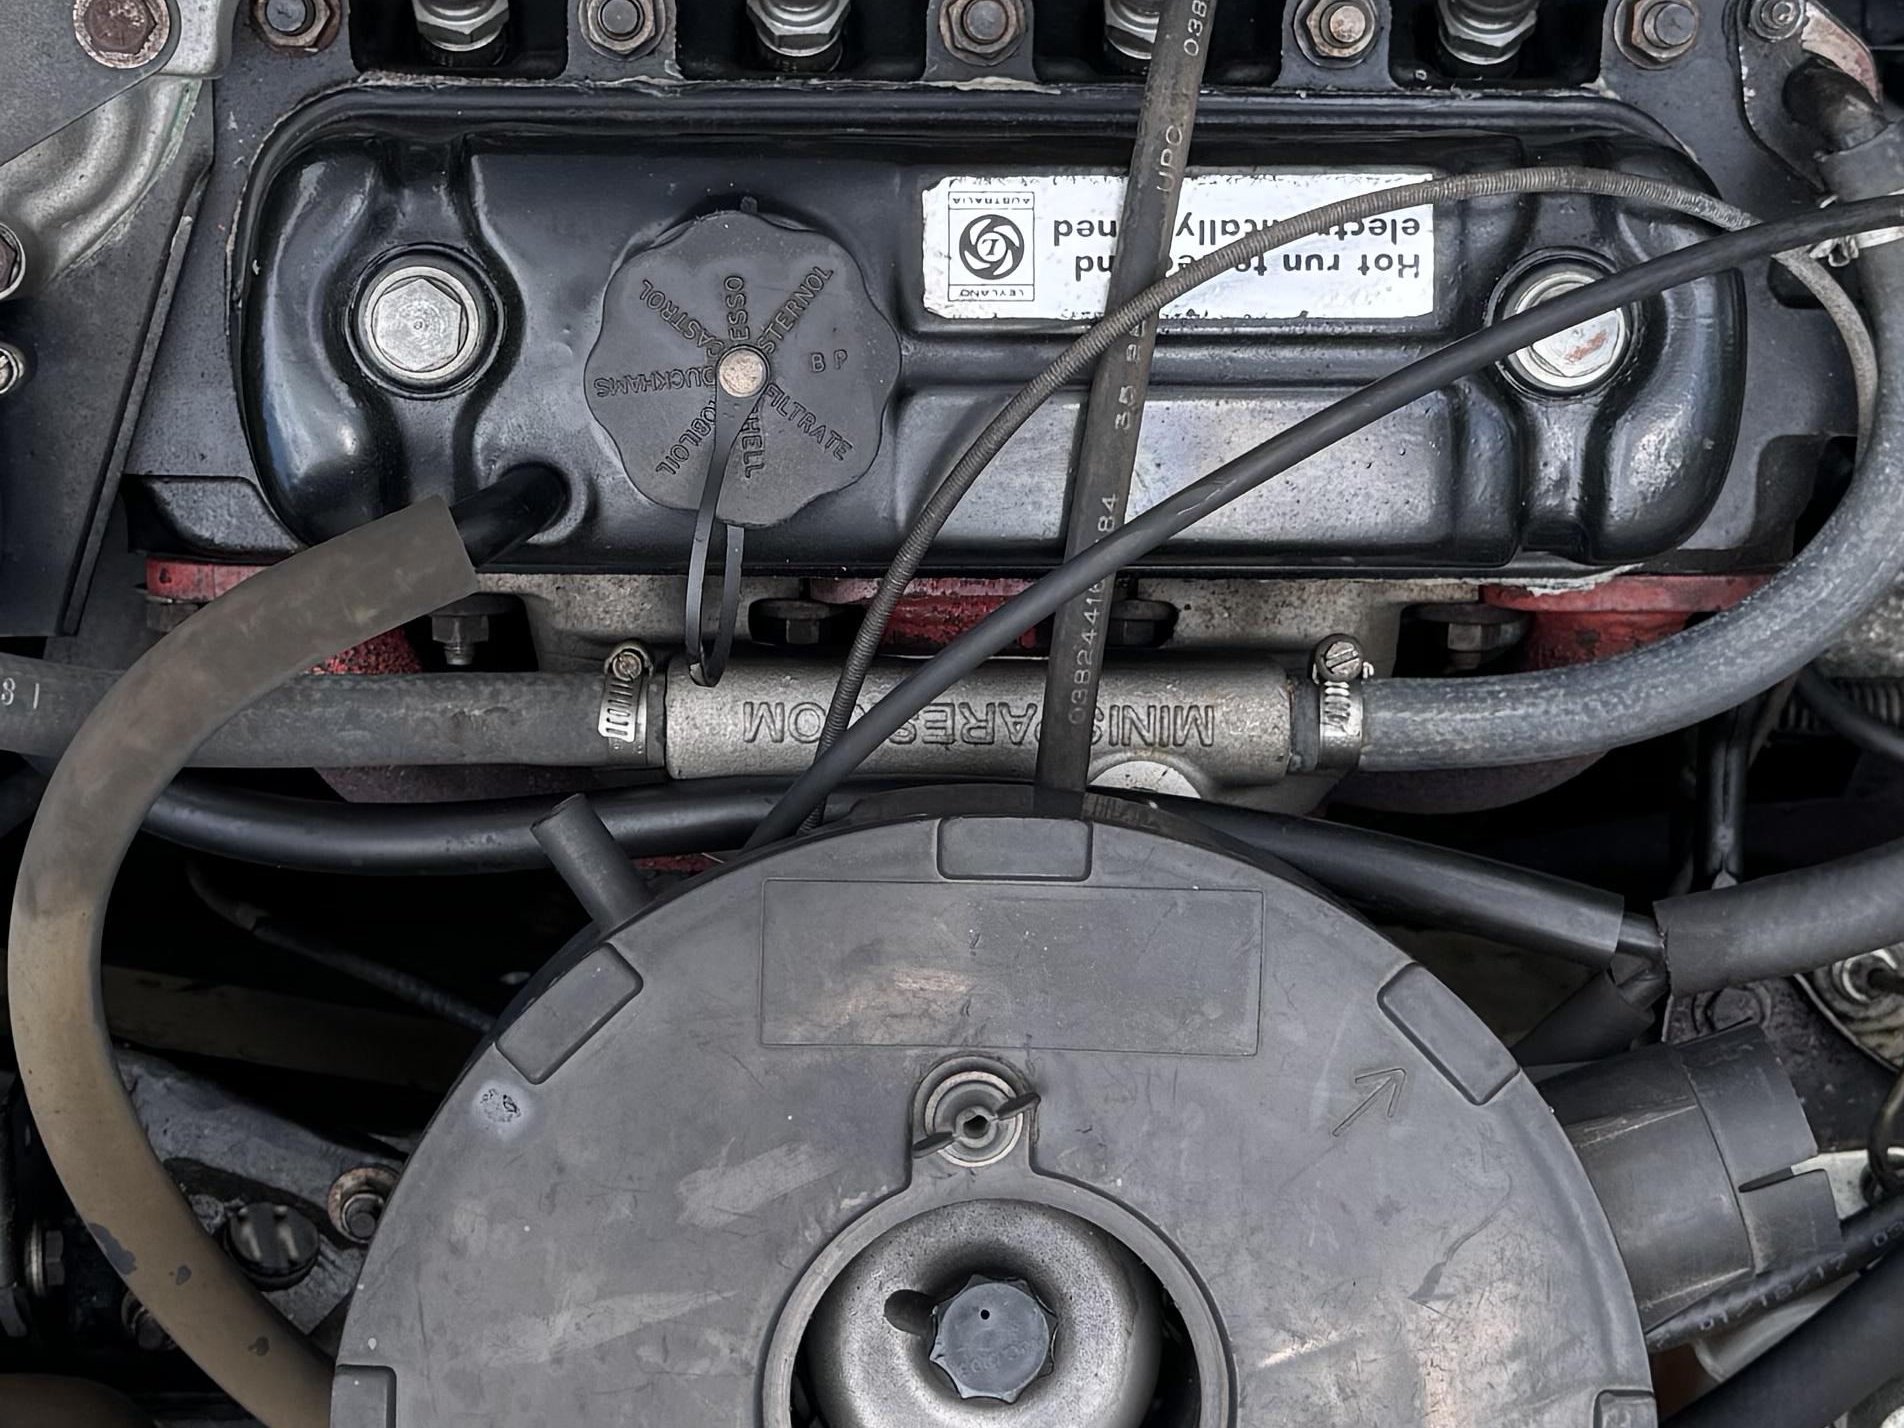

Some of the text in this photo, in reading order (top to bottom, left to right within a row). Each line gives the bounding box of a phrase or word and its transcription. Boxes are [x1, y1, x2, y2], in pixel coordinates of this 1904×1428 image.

[1156, 122, 1184, 193] UPC
[952, 194, 1032, 206] AUSTRALIA
[1053, 211, 1421, 246] electcally ned
[958, 286, 1026, 299] LEYLAND
[1075, 254, 1118, 283] nd
[1282, 253, 1341, 273] run
[638, 278, 726, 360] CASTROL
[724, 275, 751, 341] ESSO
[757, 266, 834, 354] STERNOL
[593, 366, 716, 398] DUCKHAMS
[654, 399, 717, 477] OBILOIL
[740, 406, 767, 479] HELL
[766, 383, 853, 461] FILTRATE
[1067, 493, 1119, 726] 0382441684
[742, 700, 1217, 749] MINIARESOM
